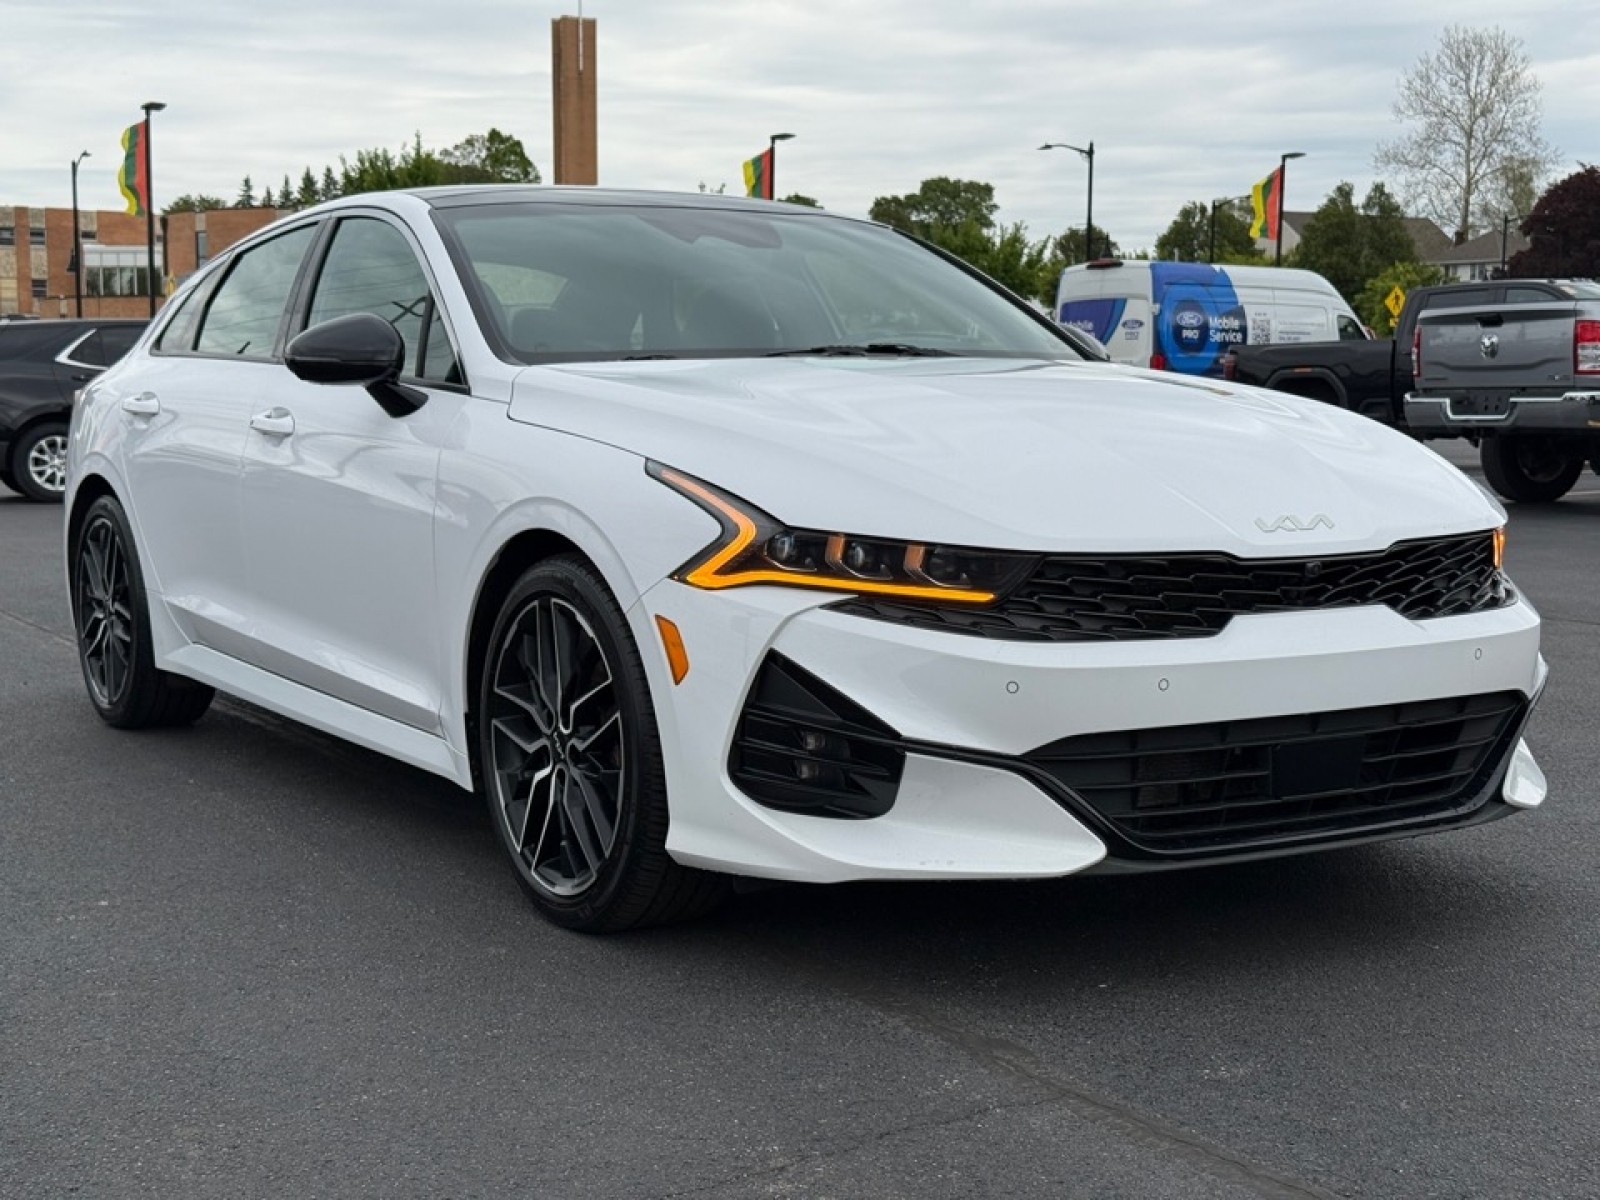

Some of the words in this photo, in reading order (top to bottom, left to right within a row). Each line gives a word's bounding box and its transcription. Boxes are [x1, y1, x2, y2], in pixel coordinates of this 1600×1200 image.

[1209, 316, 1239, 330] Mobile
[1182, 329, 1199, 340] PRO
[1209, 329, 1243, 343] Service
